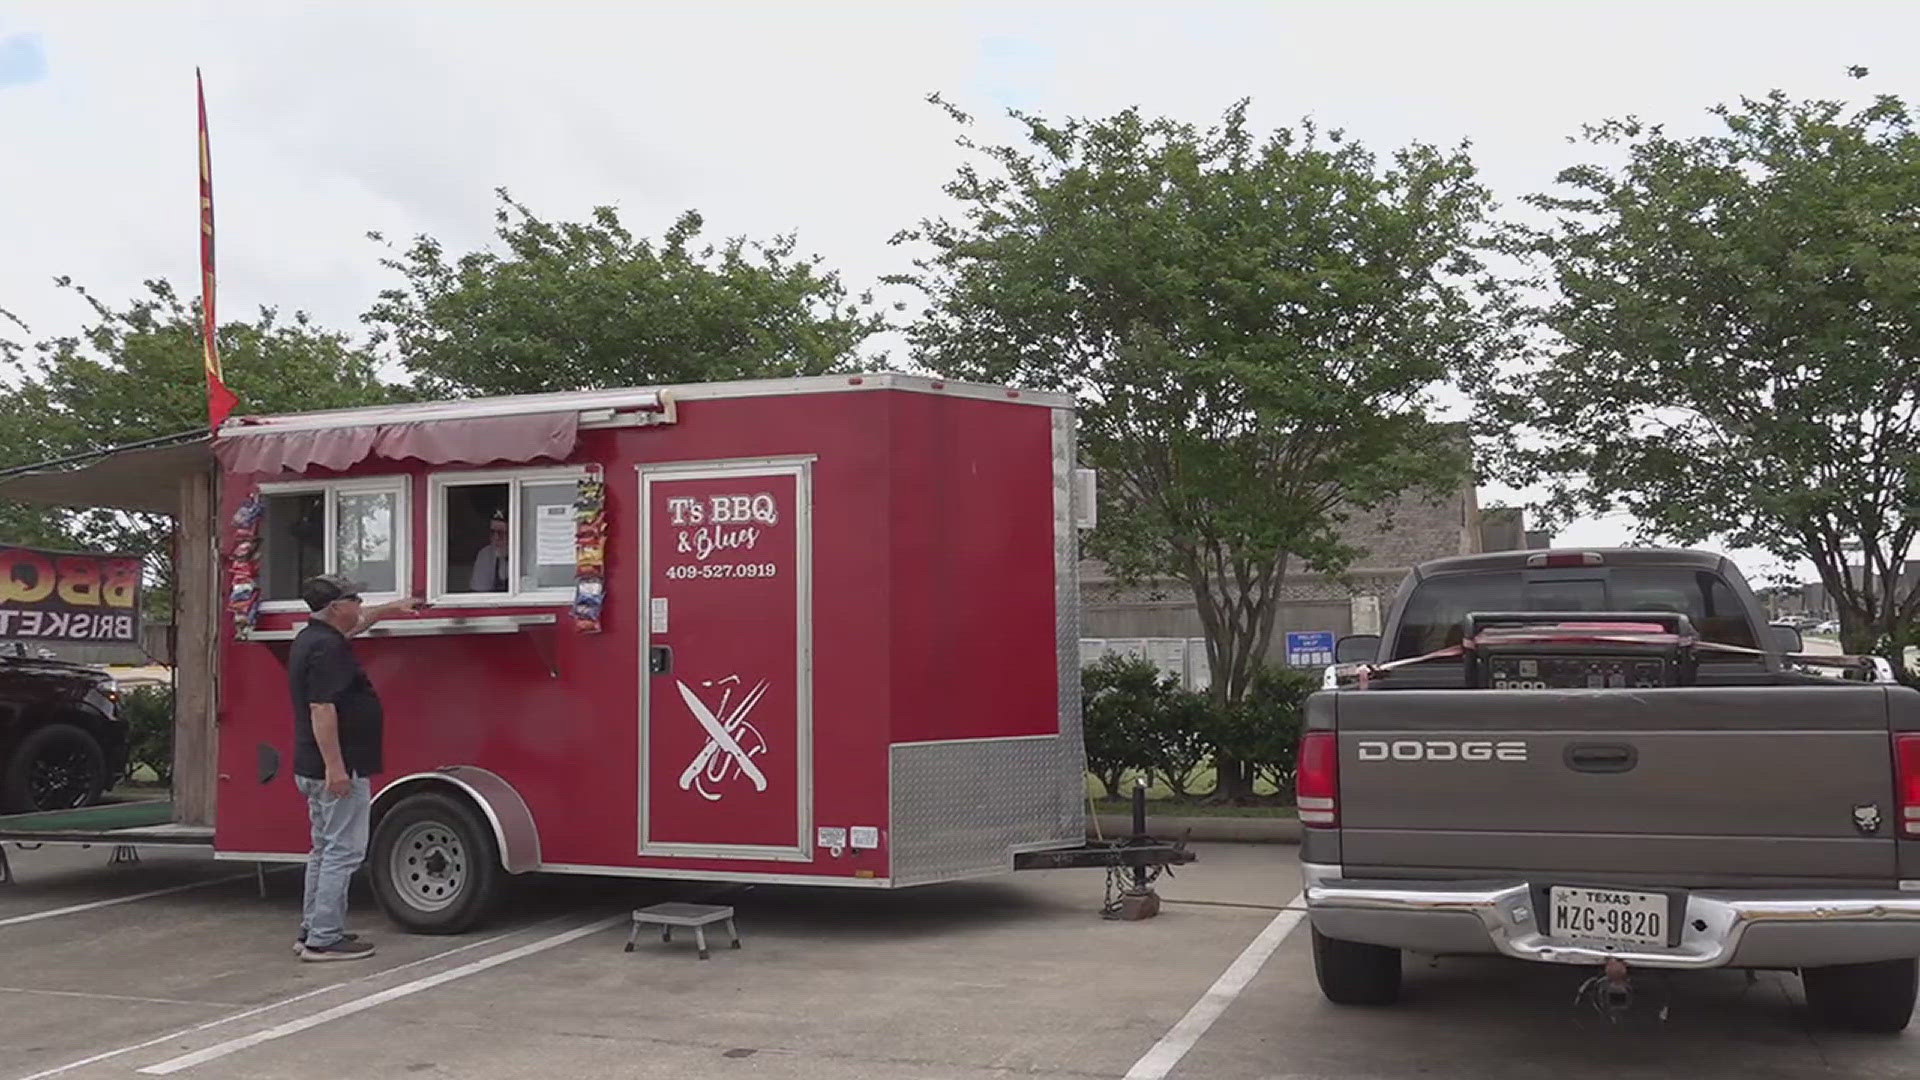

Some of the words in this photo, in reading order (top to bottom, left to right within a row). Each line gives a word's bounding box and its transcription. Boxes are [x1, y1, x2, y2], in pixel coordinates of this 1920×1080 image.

[668, 498, 704, 525] T's
[710, 494, 778, 526] BBQ
[678, 531, 693, 553] &
[694, 525, 761, 560] Blues
[665, 562, 777, 580] 409-527.0919
[1358, 741, 1528, 761] DODGE
[1585, 892, 1631, 906] TEXAS
